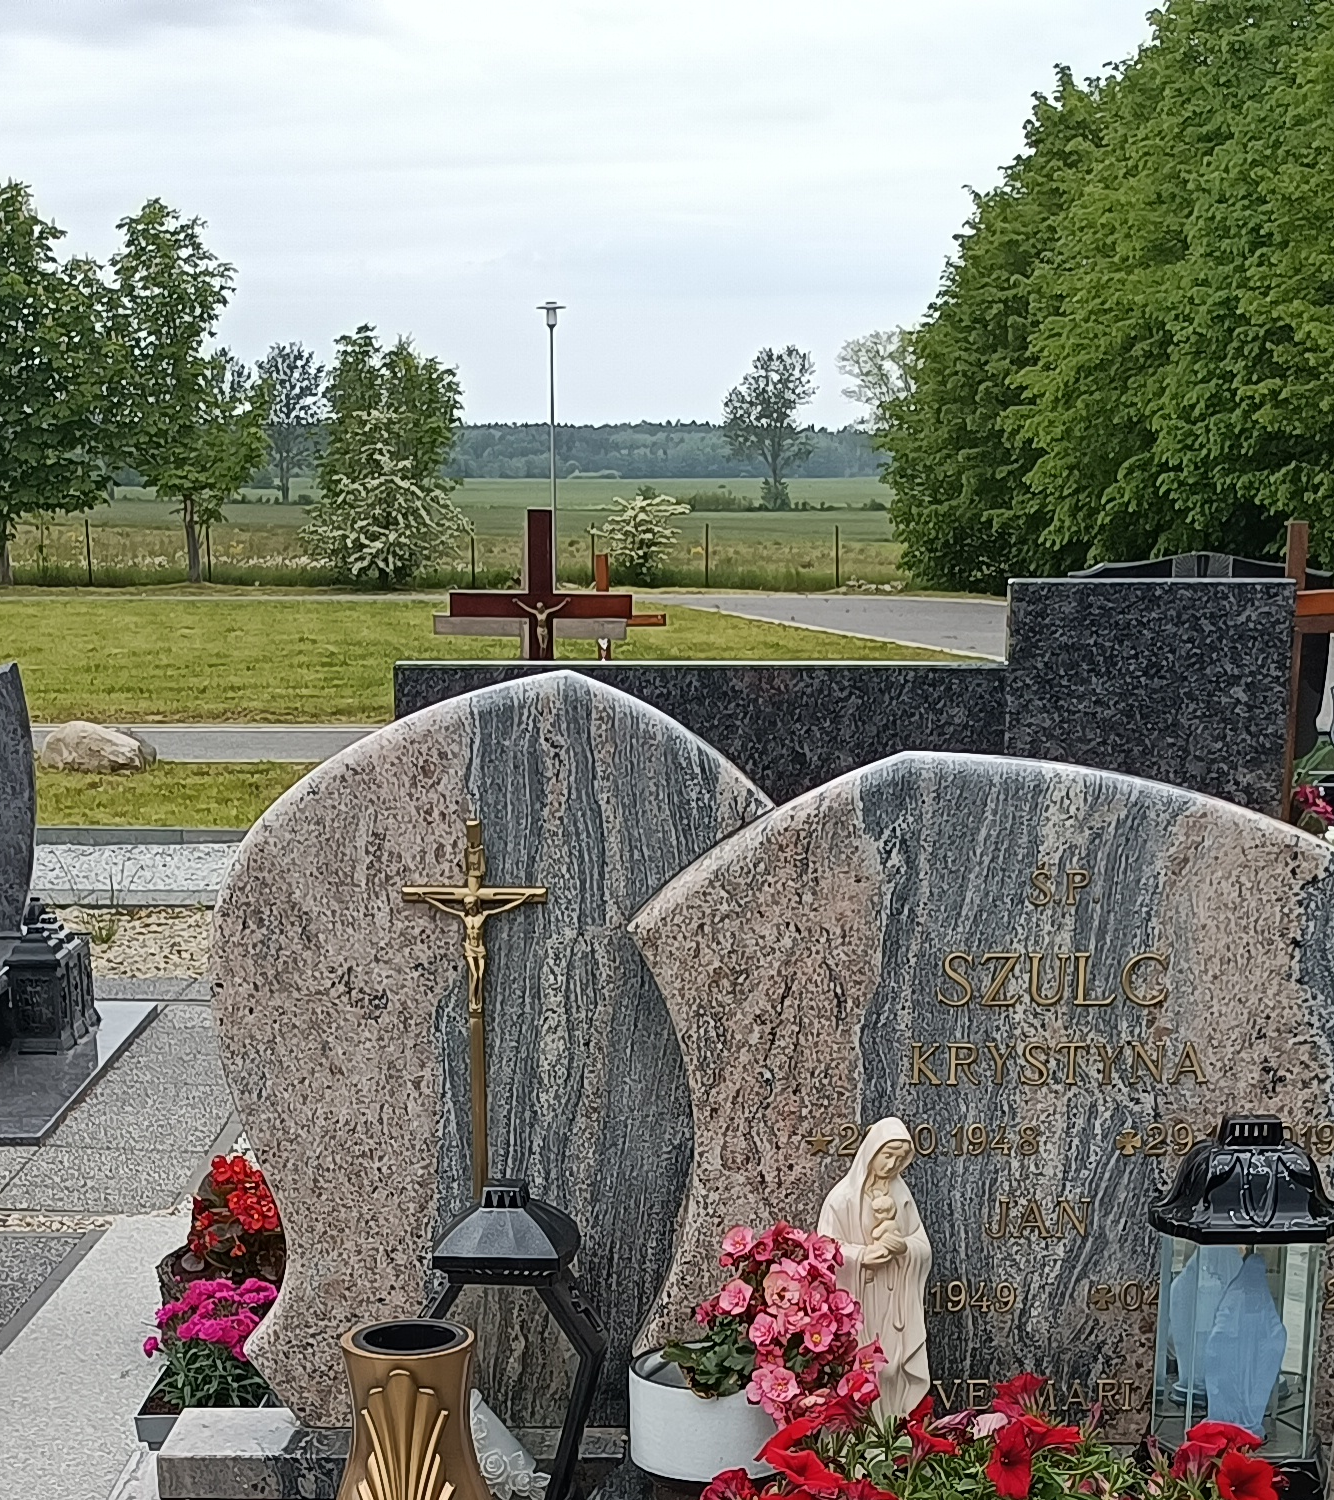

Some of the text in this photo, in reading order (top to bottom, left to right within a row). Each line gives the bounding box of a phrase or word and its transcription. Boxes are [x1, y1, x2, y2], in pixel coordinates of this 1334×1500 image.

[937, 951, 1170, 1007] SZULC
[909, 1041, 1209, 1086] KRYSTYNA
[984, 1197, 1091, 1239] JAN
